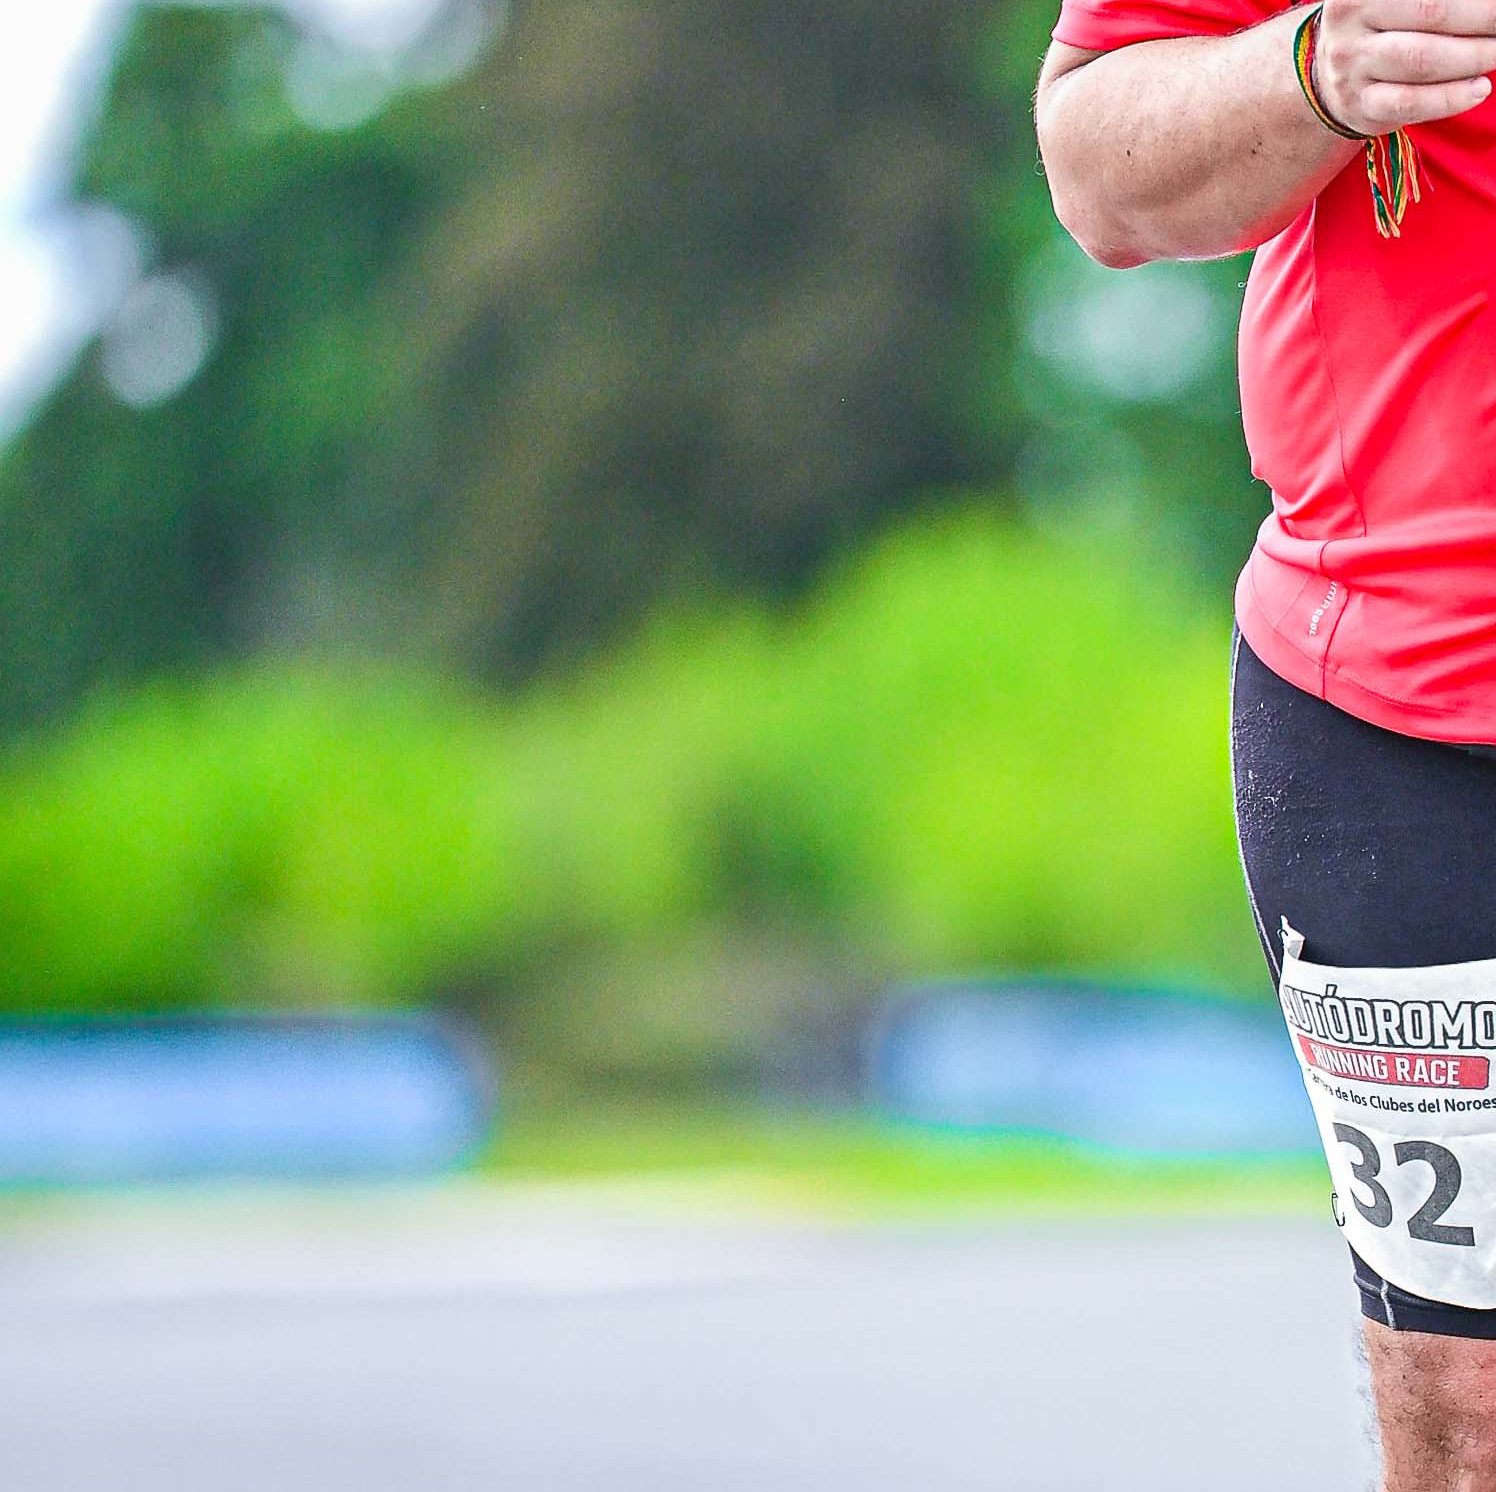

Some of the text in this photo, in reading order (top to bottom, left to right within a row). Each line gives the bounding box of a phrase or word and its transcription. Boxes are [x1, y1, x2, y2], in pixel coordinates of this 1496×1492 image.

[1308, 1042, 1461, 1086] RUNNING RACE
[1335, 1086, 1350, 1102] de
[1350, 1089, 1368, 1107] los
[1369, 1095, 1415, 1113] Clubes
[1417, 1098, 1441, 1114] del
[1333, 1121, 1476, 1247] 32
